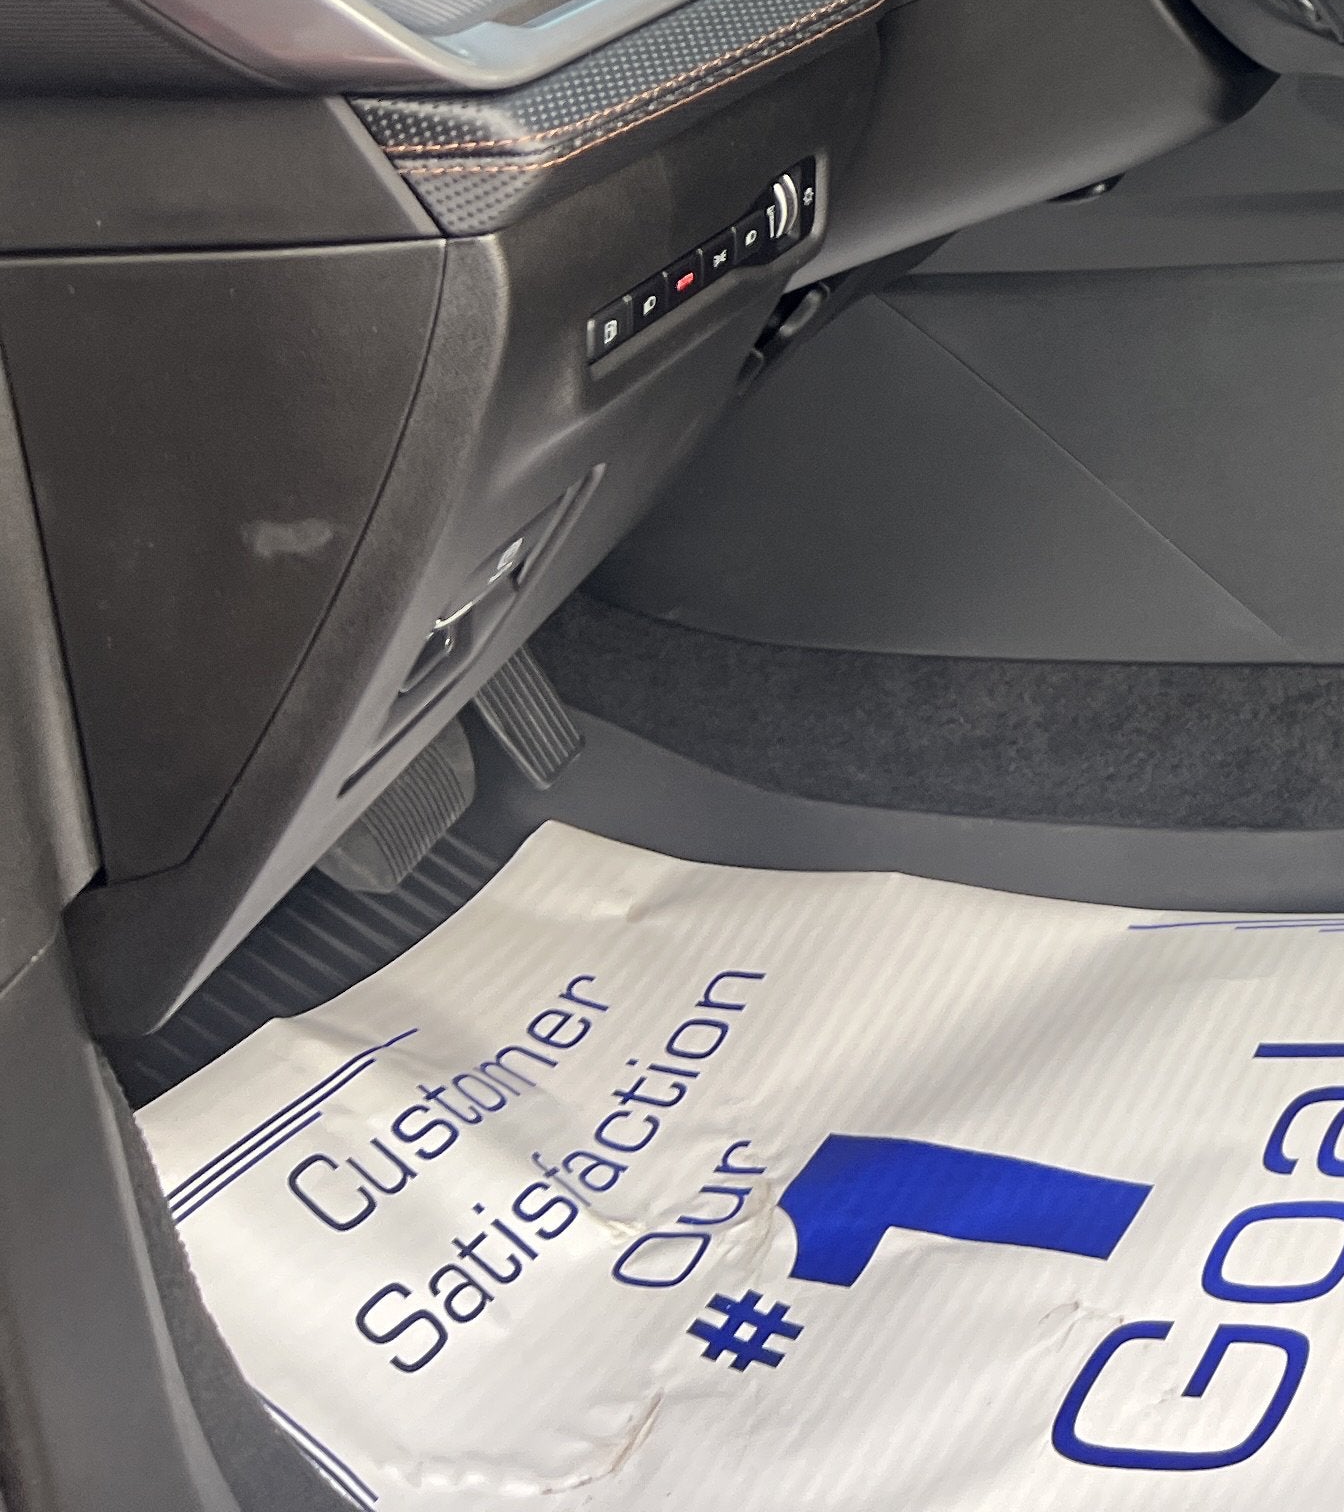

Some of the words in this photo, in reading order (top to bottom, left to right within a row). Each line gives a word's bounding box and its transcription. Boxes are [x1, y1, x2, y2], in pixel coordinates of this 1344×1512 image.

[288, 973, 609, 1232] Customer
[355, 970, 766, 1373] Satisfaction
[612, 1140, 767, 1288] Our
